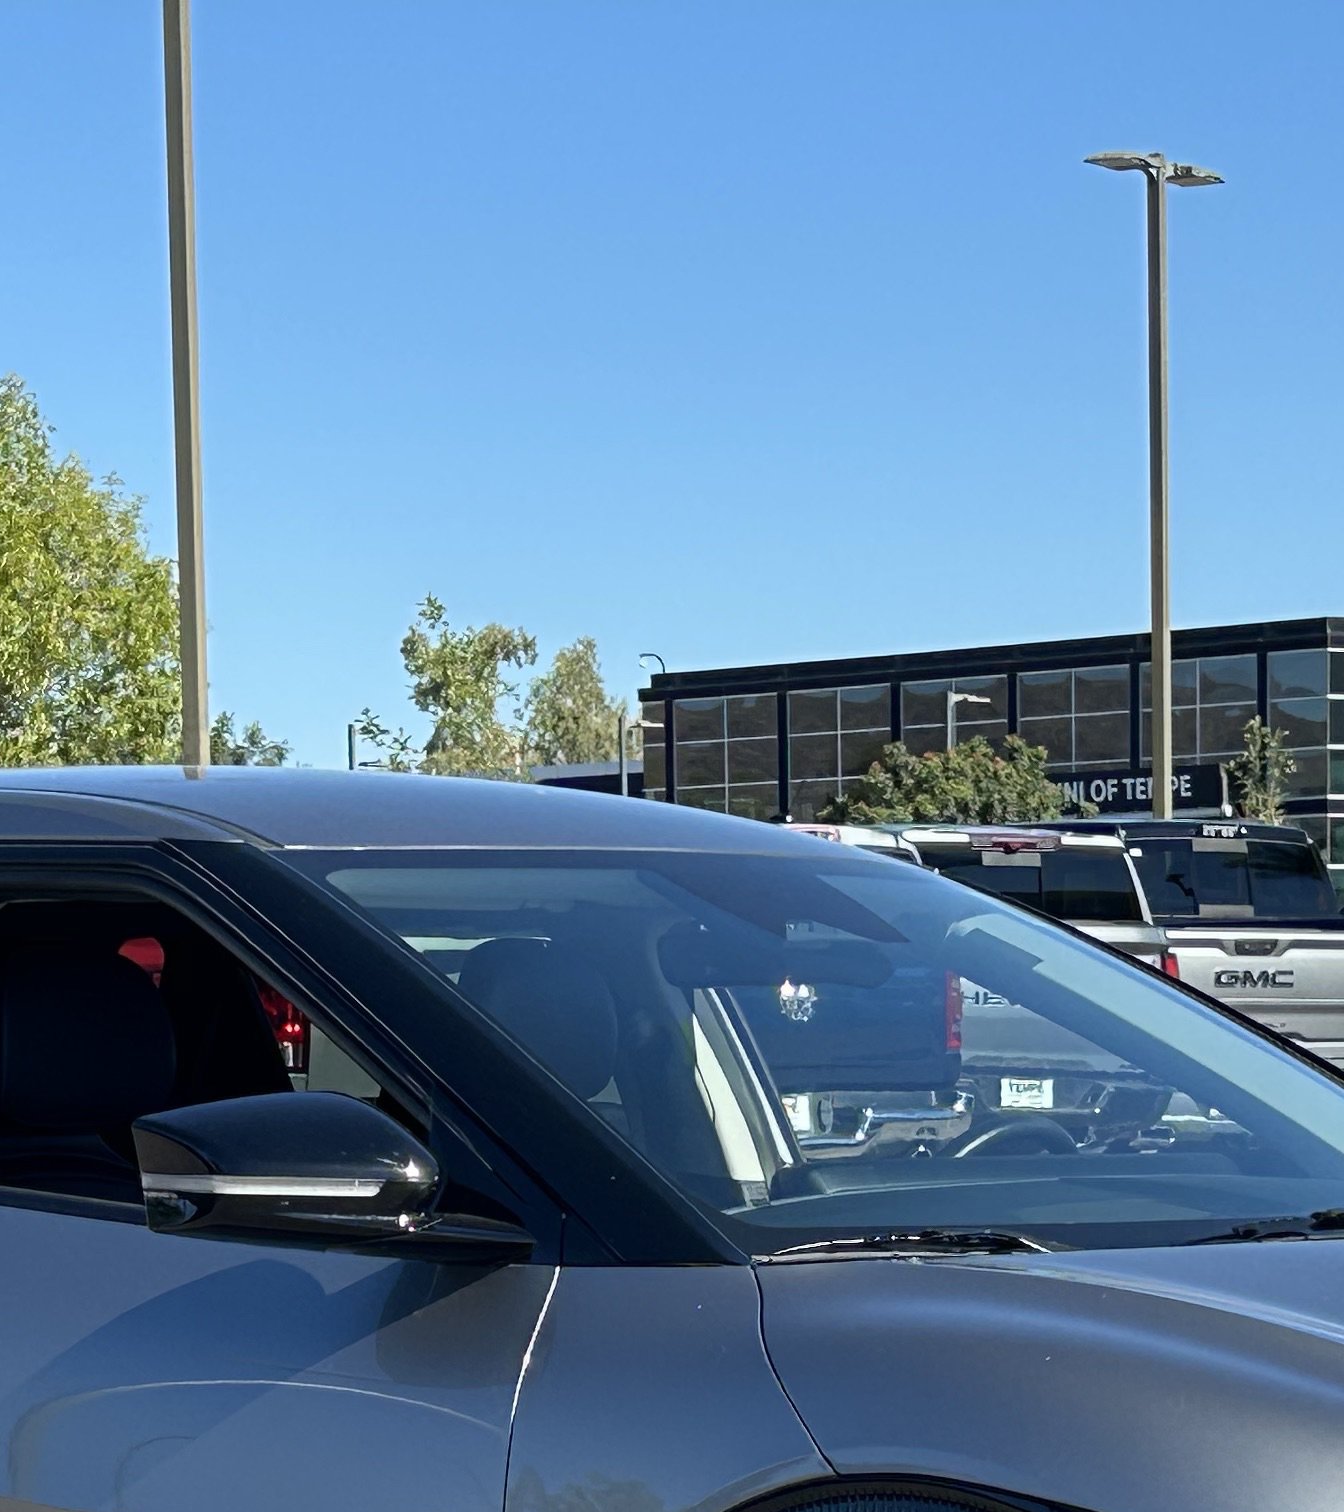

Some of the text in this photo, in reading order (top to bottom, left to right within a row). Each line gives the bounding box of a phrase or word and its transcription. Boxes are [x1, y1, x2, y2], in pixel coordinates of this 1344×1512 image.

[1090, 778, 1118, 801] OF
[1122, 774, 1193, 800] TEPE
[1214, 969, 1295, 988] GMC
